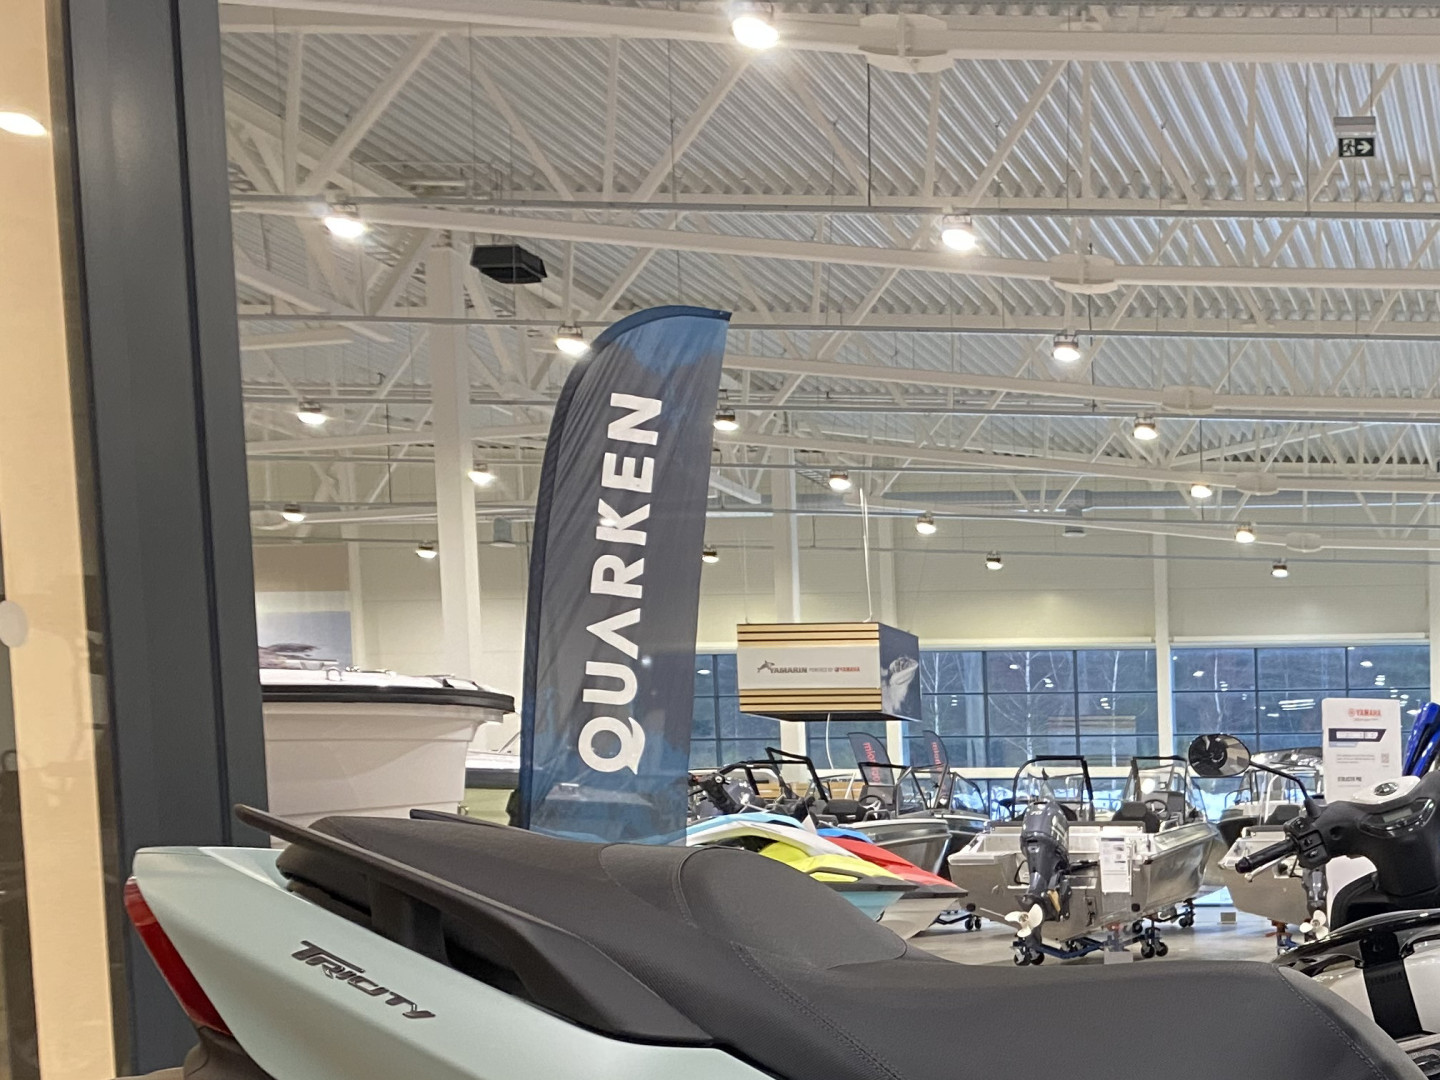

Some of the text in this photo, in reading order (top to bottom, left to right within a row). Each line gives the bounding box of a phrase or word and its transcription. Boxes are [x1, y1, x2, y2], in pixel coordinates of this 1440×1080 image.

[578, 392, 662, 775] QUARKEN
[1356, 709, 1382, 717] YAMAHA
[291, 940, 436, 1019] TRICITY
